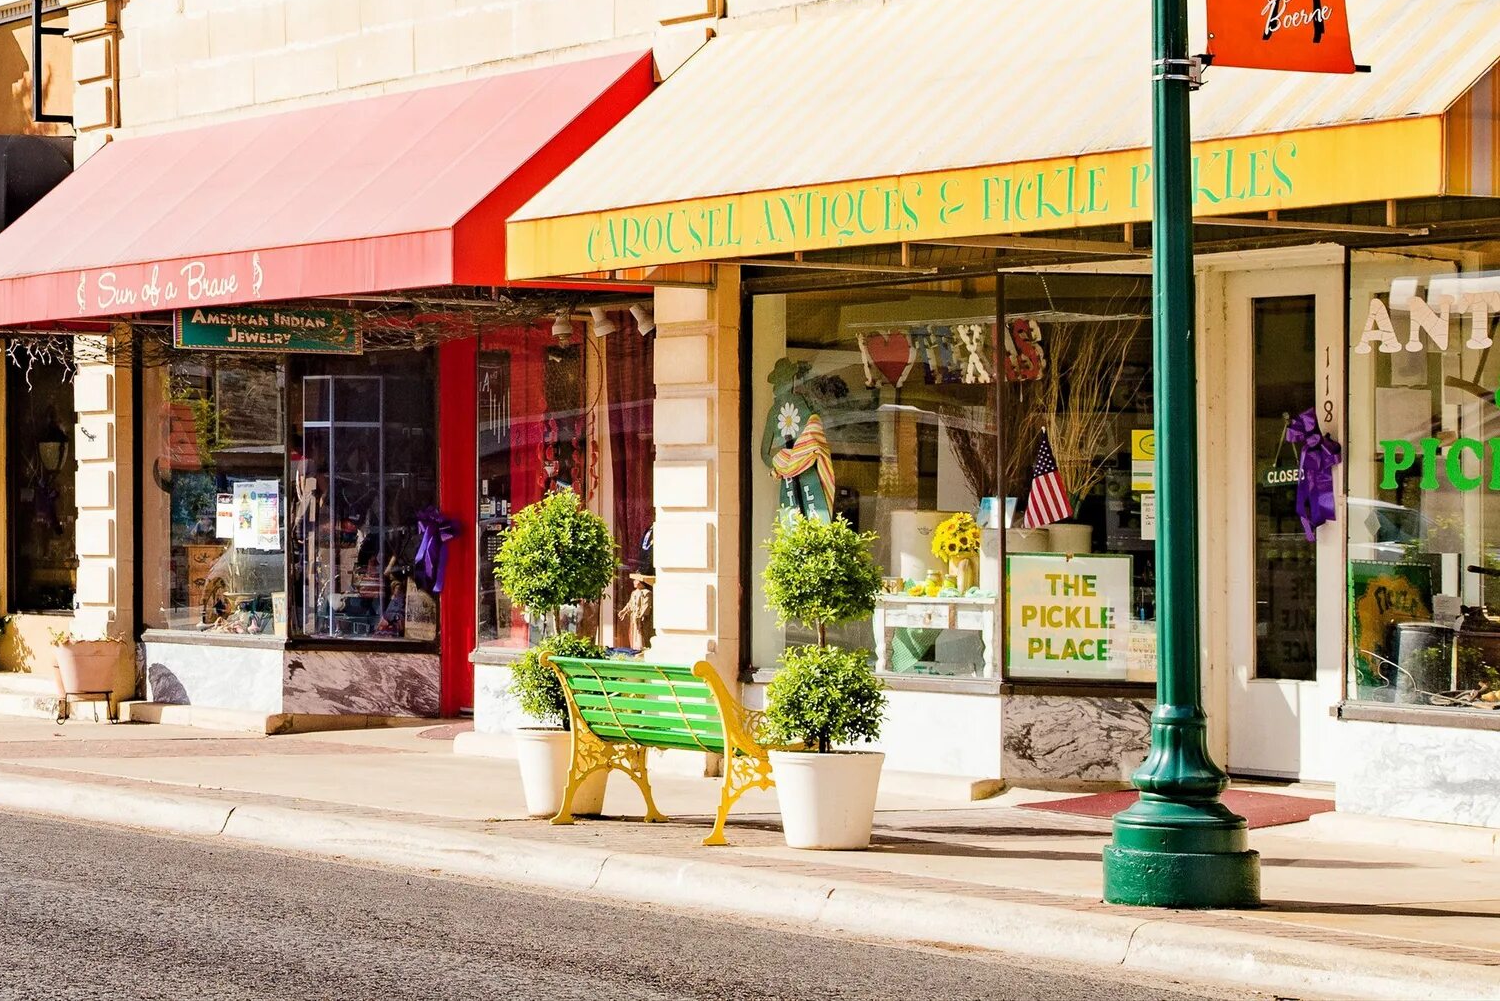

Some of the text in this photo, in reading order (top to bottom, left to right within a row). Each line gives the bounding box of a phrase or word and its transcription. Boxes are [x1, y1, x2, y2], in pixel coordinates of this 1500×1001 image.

[586, 140, 1298, 264] CAROUSEL ANTIQUES & FICKLE PKLES
[98, 261, 238, 308] Sun of a Brave
[1323, 346, 1334, 422] 118
[1044, 574, 1097, 597] THE
[1021, 605, 1116, 629] PICKLE
[1028, 637, 1114, 661] PLACE
